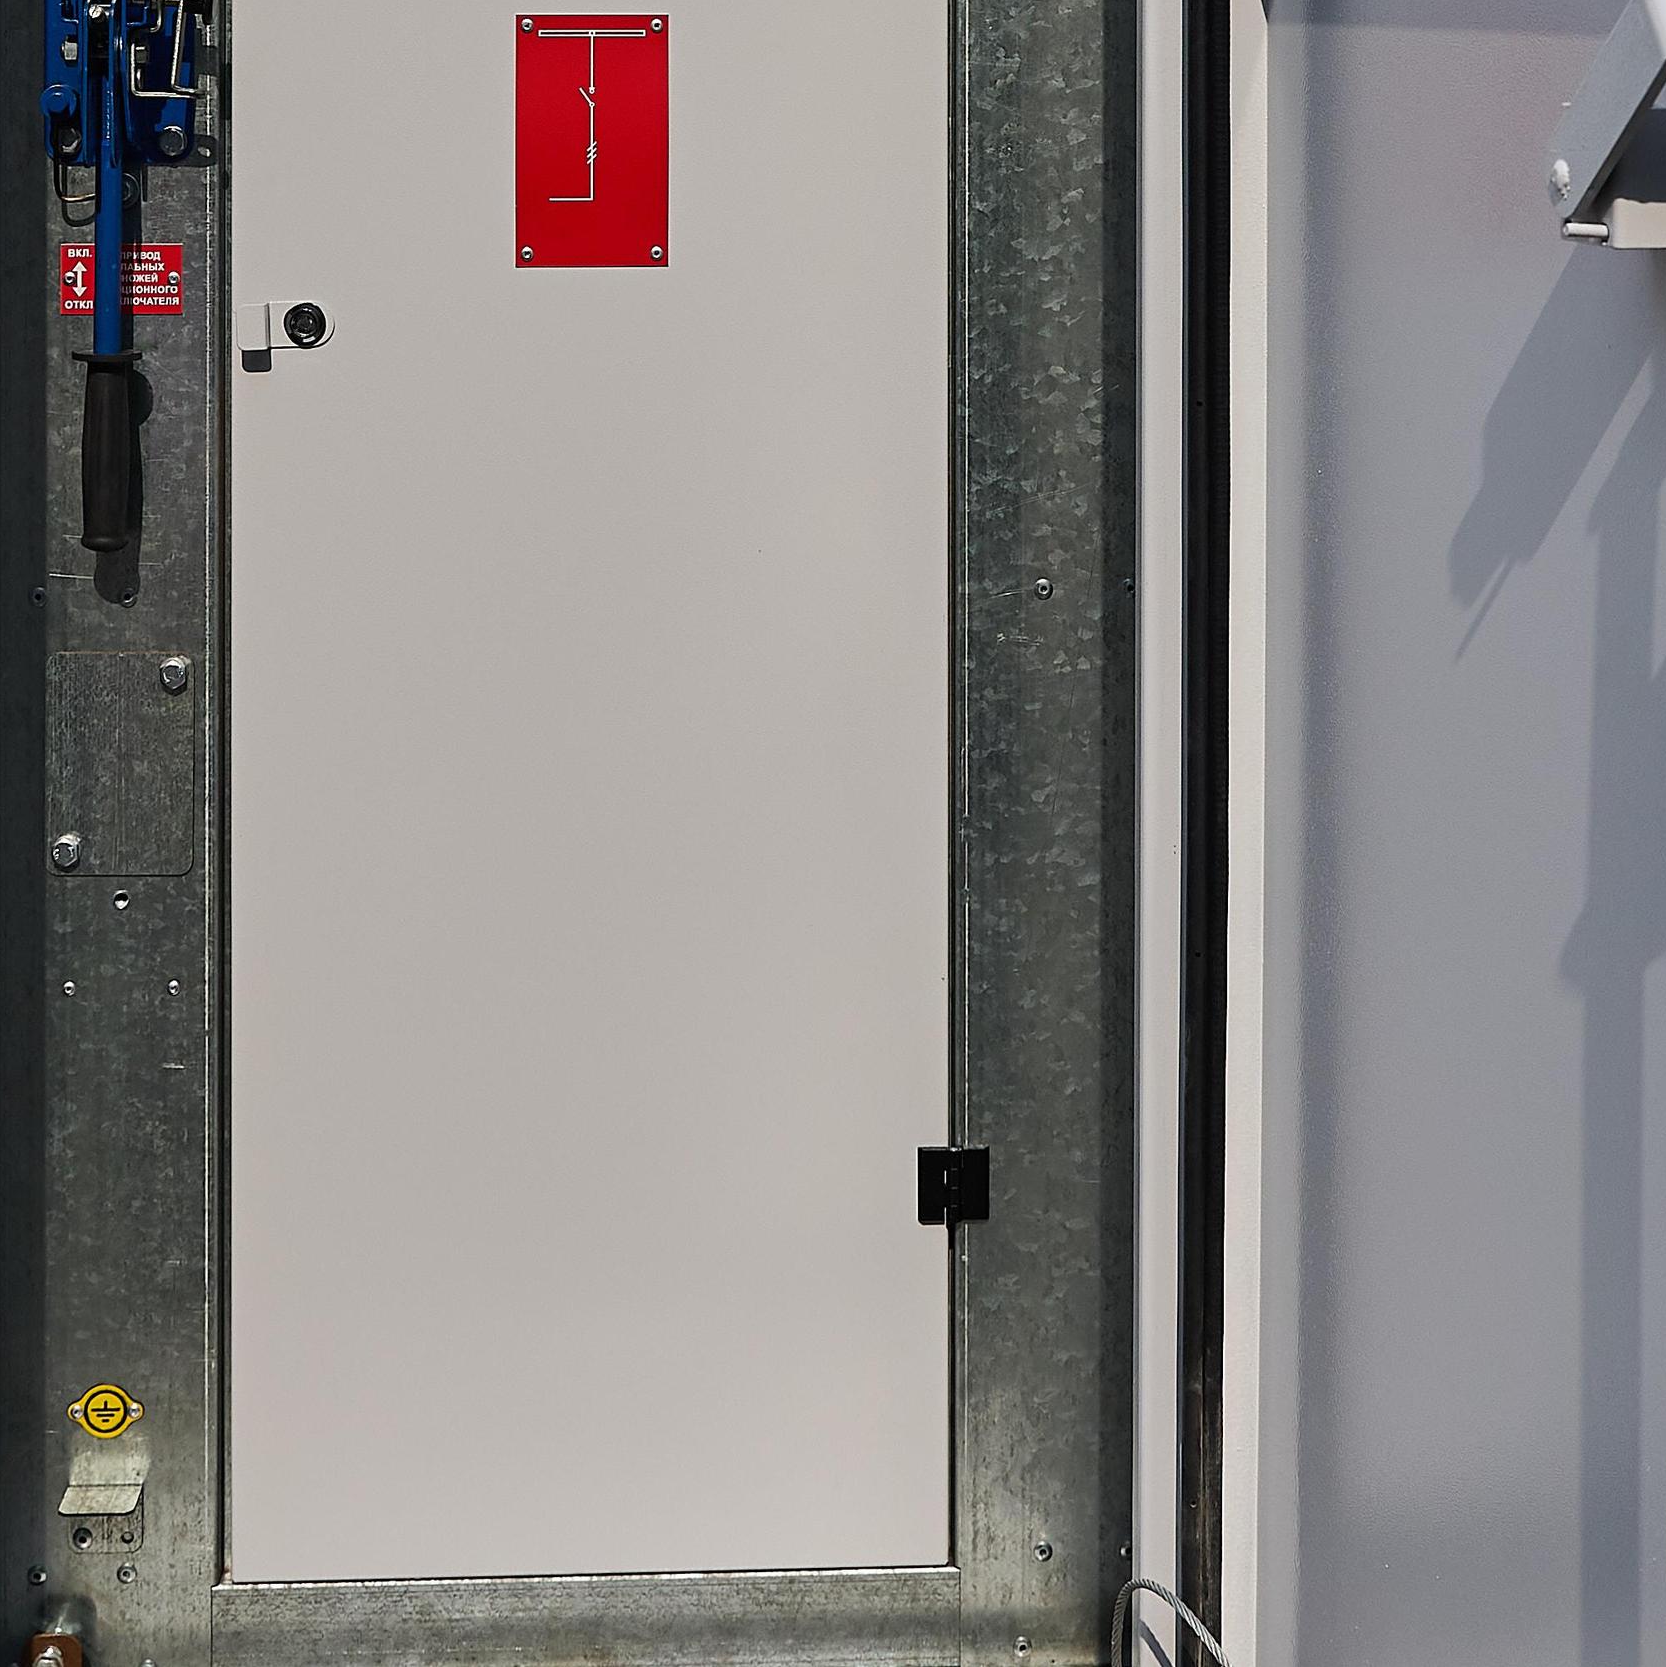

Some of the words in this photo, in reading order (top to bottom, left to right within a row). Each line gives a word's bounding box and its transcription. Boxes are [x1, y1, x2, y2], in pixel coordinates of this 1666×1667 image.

[67, 248, 93, 258] ВКЛ.
[121, 285, 178, 295] ЦИОННОГО
[120, 297, 180, 306] ЛЮЧАТЕЛЯ
